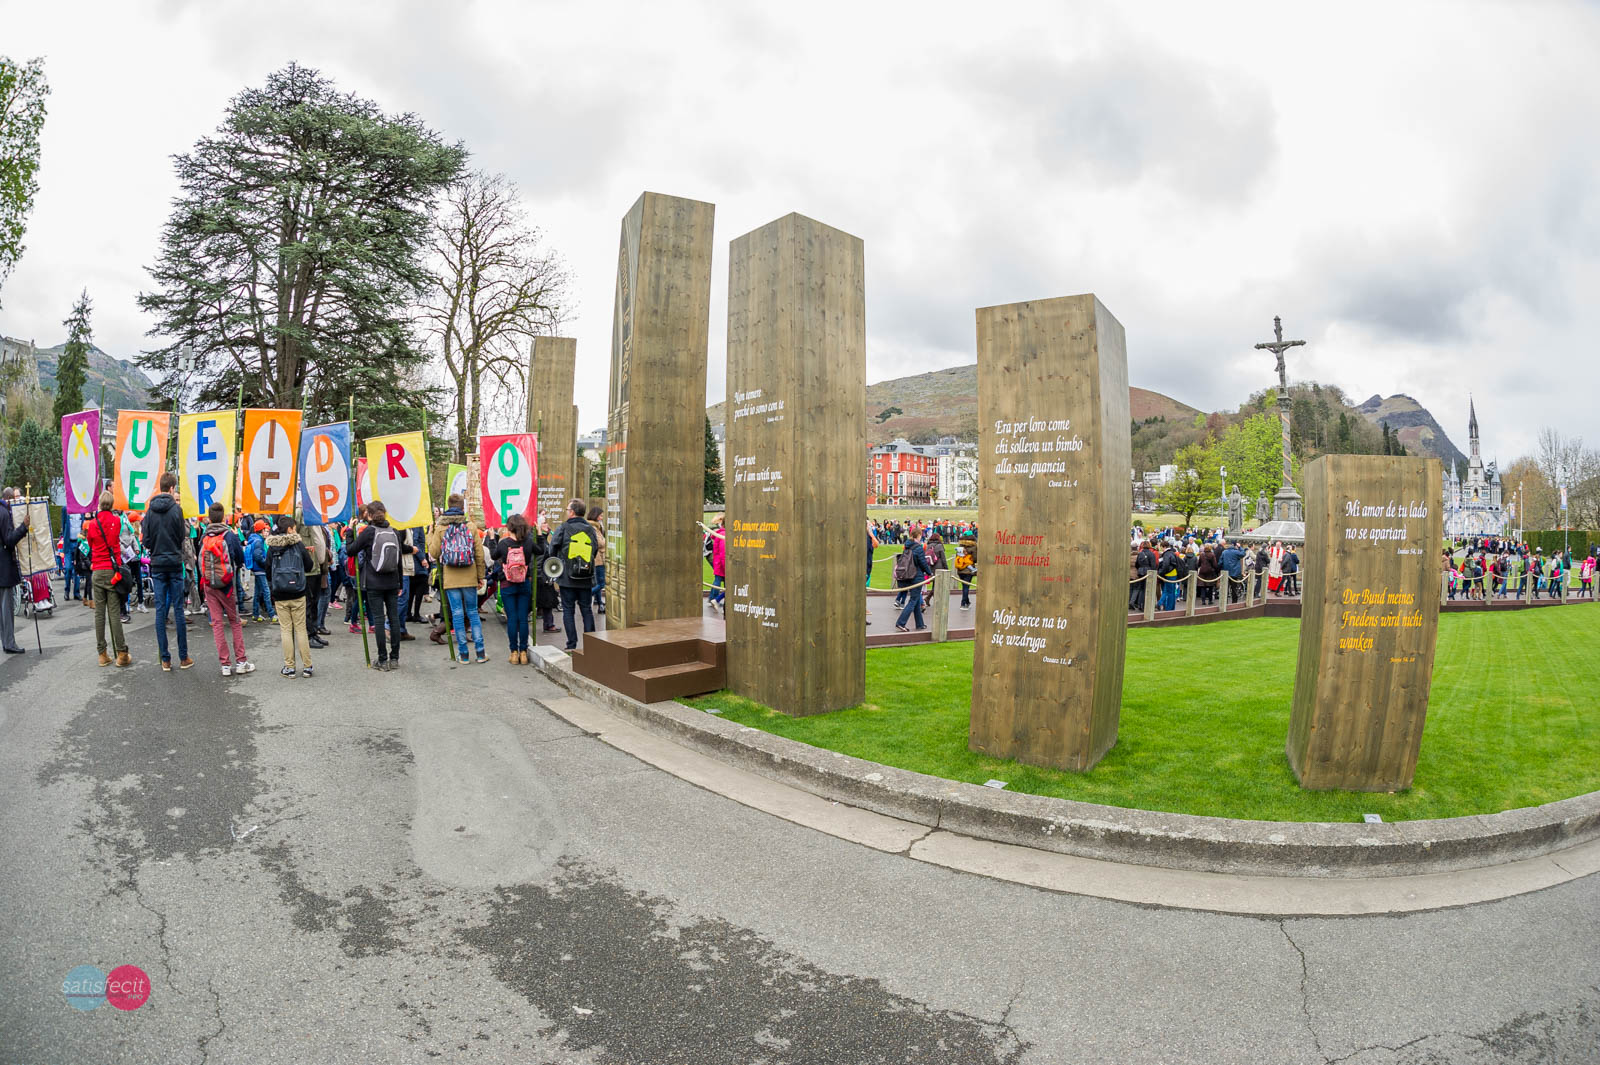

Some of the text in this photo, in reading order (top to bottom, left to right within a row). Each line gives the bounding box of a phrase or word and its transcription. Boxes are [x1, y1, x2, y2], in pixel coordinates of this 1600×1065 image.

[995, 416, 1070, 438] Era per loro come
[71, 420, 89, 459] X
[131, 419, 153, 459] U
[197, 420, 217, 462] E
[268, 419, 277, 459] I
[995, 434, 1083, 454] chi solleva un bimbo
[313, 434, 334, 473] D
[385, 442, 409, 481] R
[498, 442, 519, 478] O
[734, 455, 756, 468] Fear not
[734, 470, 743, 487] for
[744, 470, 747, 482] I
[756, 466, 770, 481] with
[995, 457, 1065, 479] alla sua guancia
[128, 471, 148, 511] E
[197, 474, 217, 515] R
[259, 471, 280, 511] E
[318, 484, 340, 523] P
[1346, 499, 1428, 518] Mi amor de tu lado
[742, 522, 760, 532] amore
[1346, 528, 1357, 540] no
[1358, 528, 1368, 540] se
[1019, 535, 1045, 546] amor
[995, 550, 1050, 567] não mudará
[738, 584, 749, 597] will
[1343, 587, 1415, 605] Der Bund meines
[734, 600, 776, 620] never forget you
[992, 608, 1067, 630] Moje serce na to
[1341, 609, 1423, 630] Friedens wird nicht
[991, 630, 1046, 653] się wzdryga
[1340, 631, 1374, 652] wanken
